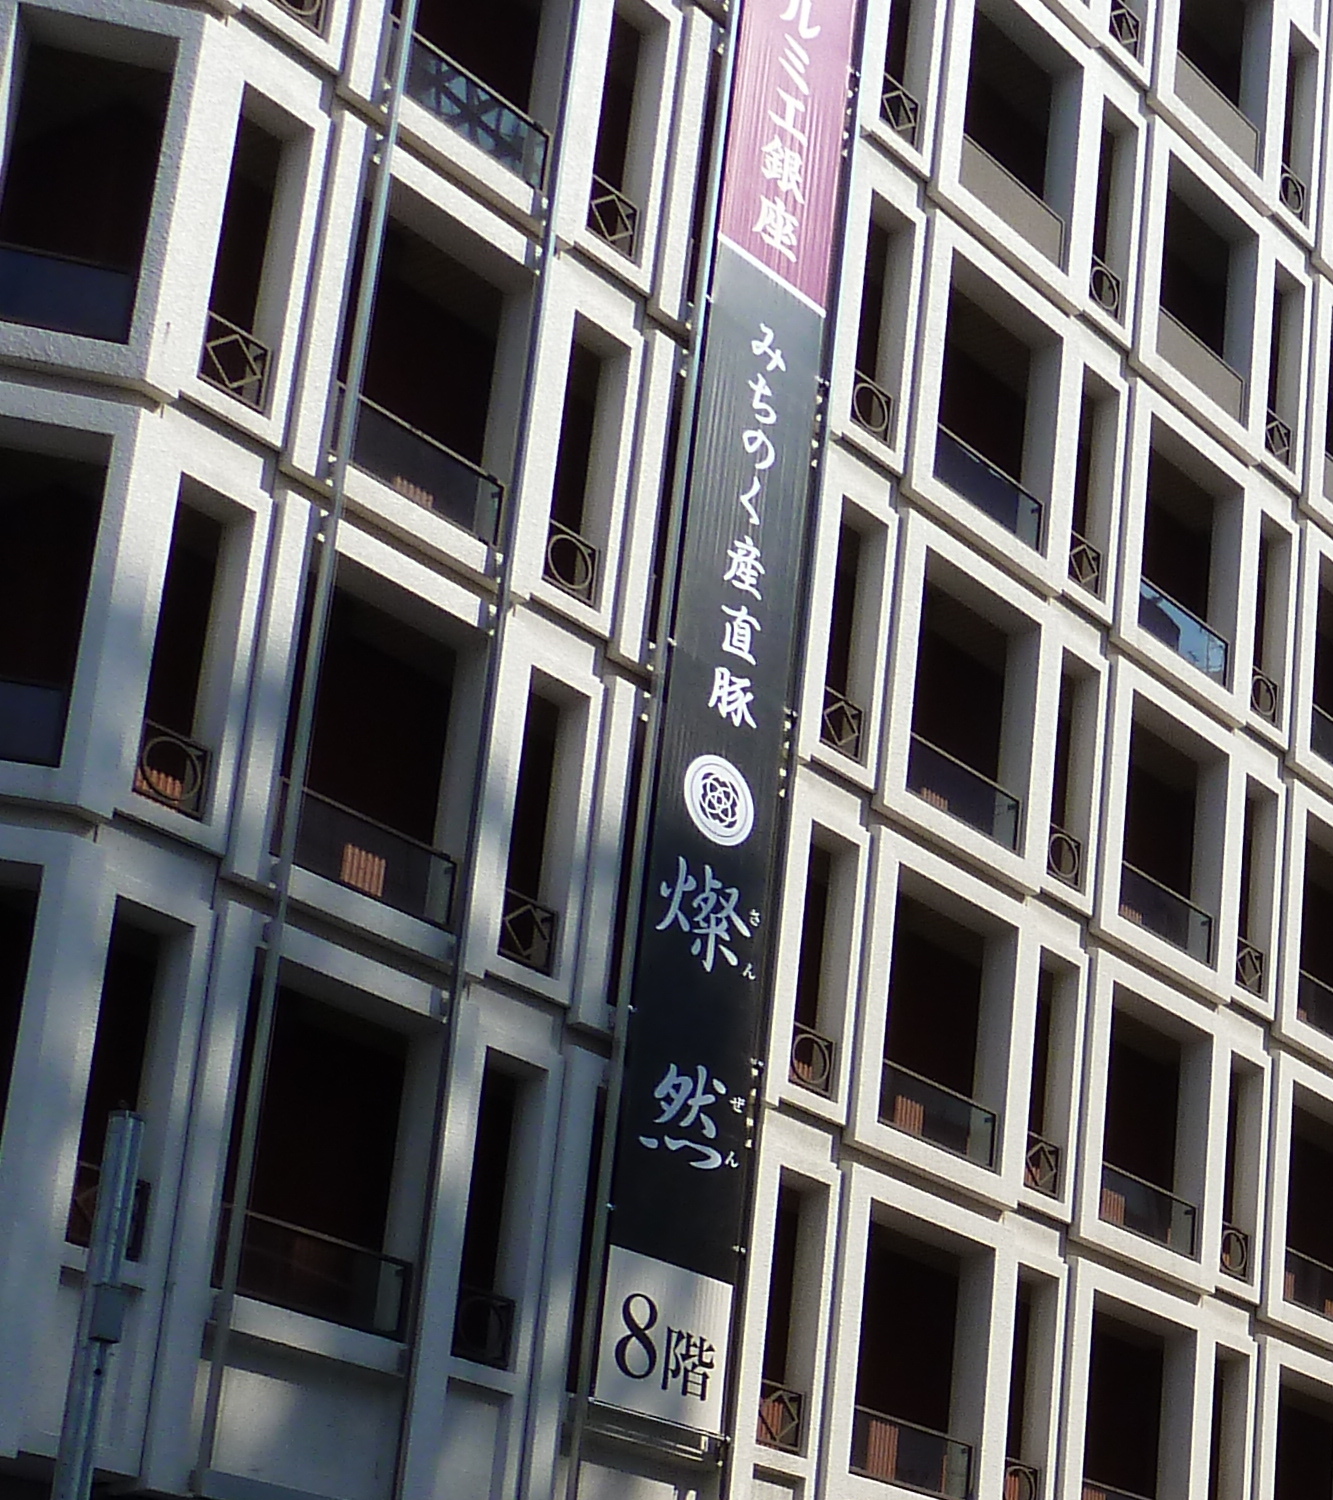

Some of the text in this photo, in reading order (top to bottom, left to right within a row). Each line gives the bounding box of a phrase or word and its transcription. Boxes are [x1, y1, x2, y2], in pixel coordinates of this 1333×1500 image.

[708, 323, 788, 729] みちのく産直豚
[617, 1292, 718, 1402] 8階
